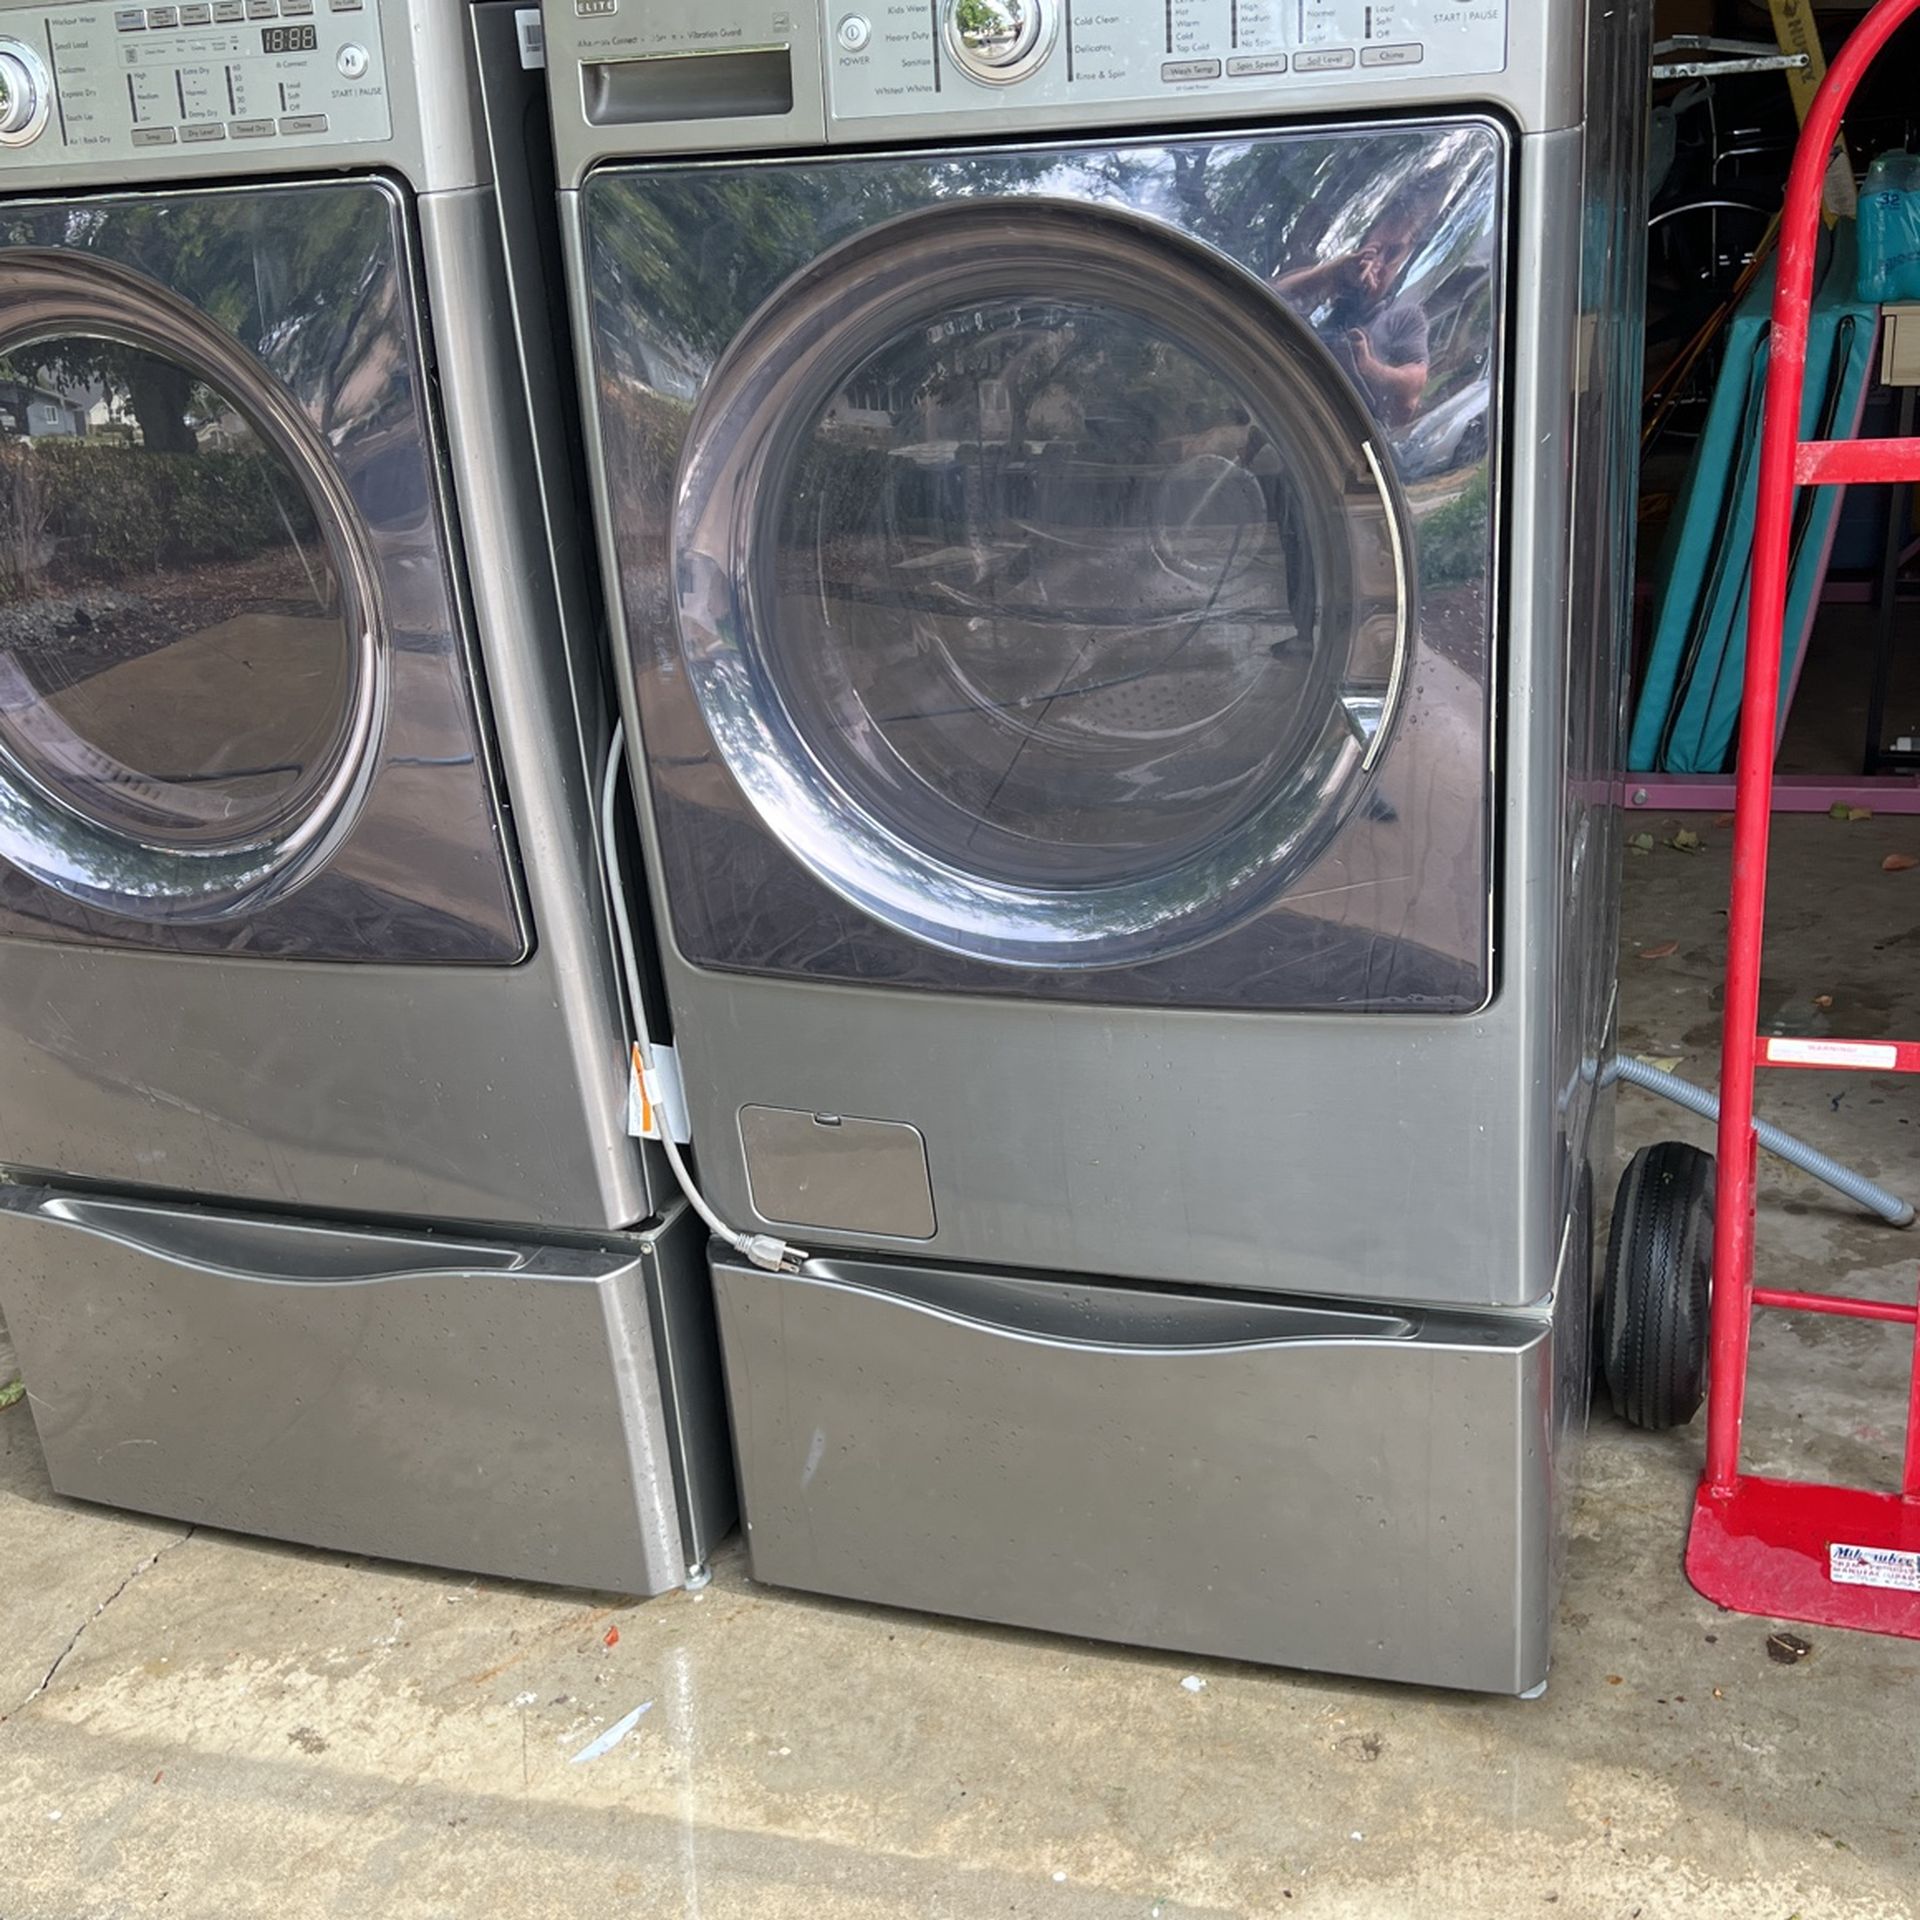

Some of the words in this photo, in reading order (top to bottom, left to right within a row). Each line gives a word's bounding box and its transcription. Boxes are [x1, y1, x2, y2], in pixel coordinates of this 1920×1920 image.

[578, 1, 614, 13] ELITE
[887, 6, 905, 14] Kids
[1074, 16, 1093, 26] Cold
[1095, 15, 1119, 24] Clean
[1433, 12, 1461, 24] START
[1469, 9, 1498, 20] PAUSE
[885, 33, 909, 42] Heavy
[911, 30, 930, 40] Duty
[1176, 32, 1193, 40] Cold
[1075, 44, 1112, 53] Delicates
[839, 56, 871, 66] POWER
[331, 89, 354, 98] START
[359, 87, 382, 96] PAUSE
